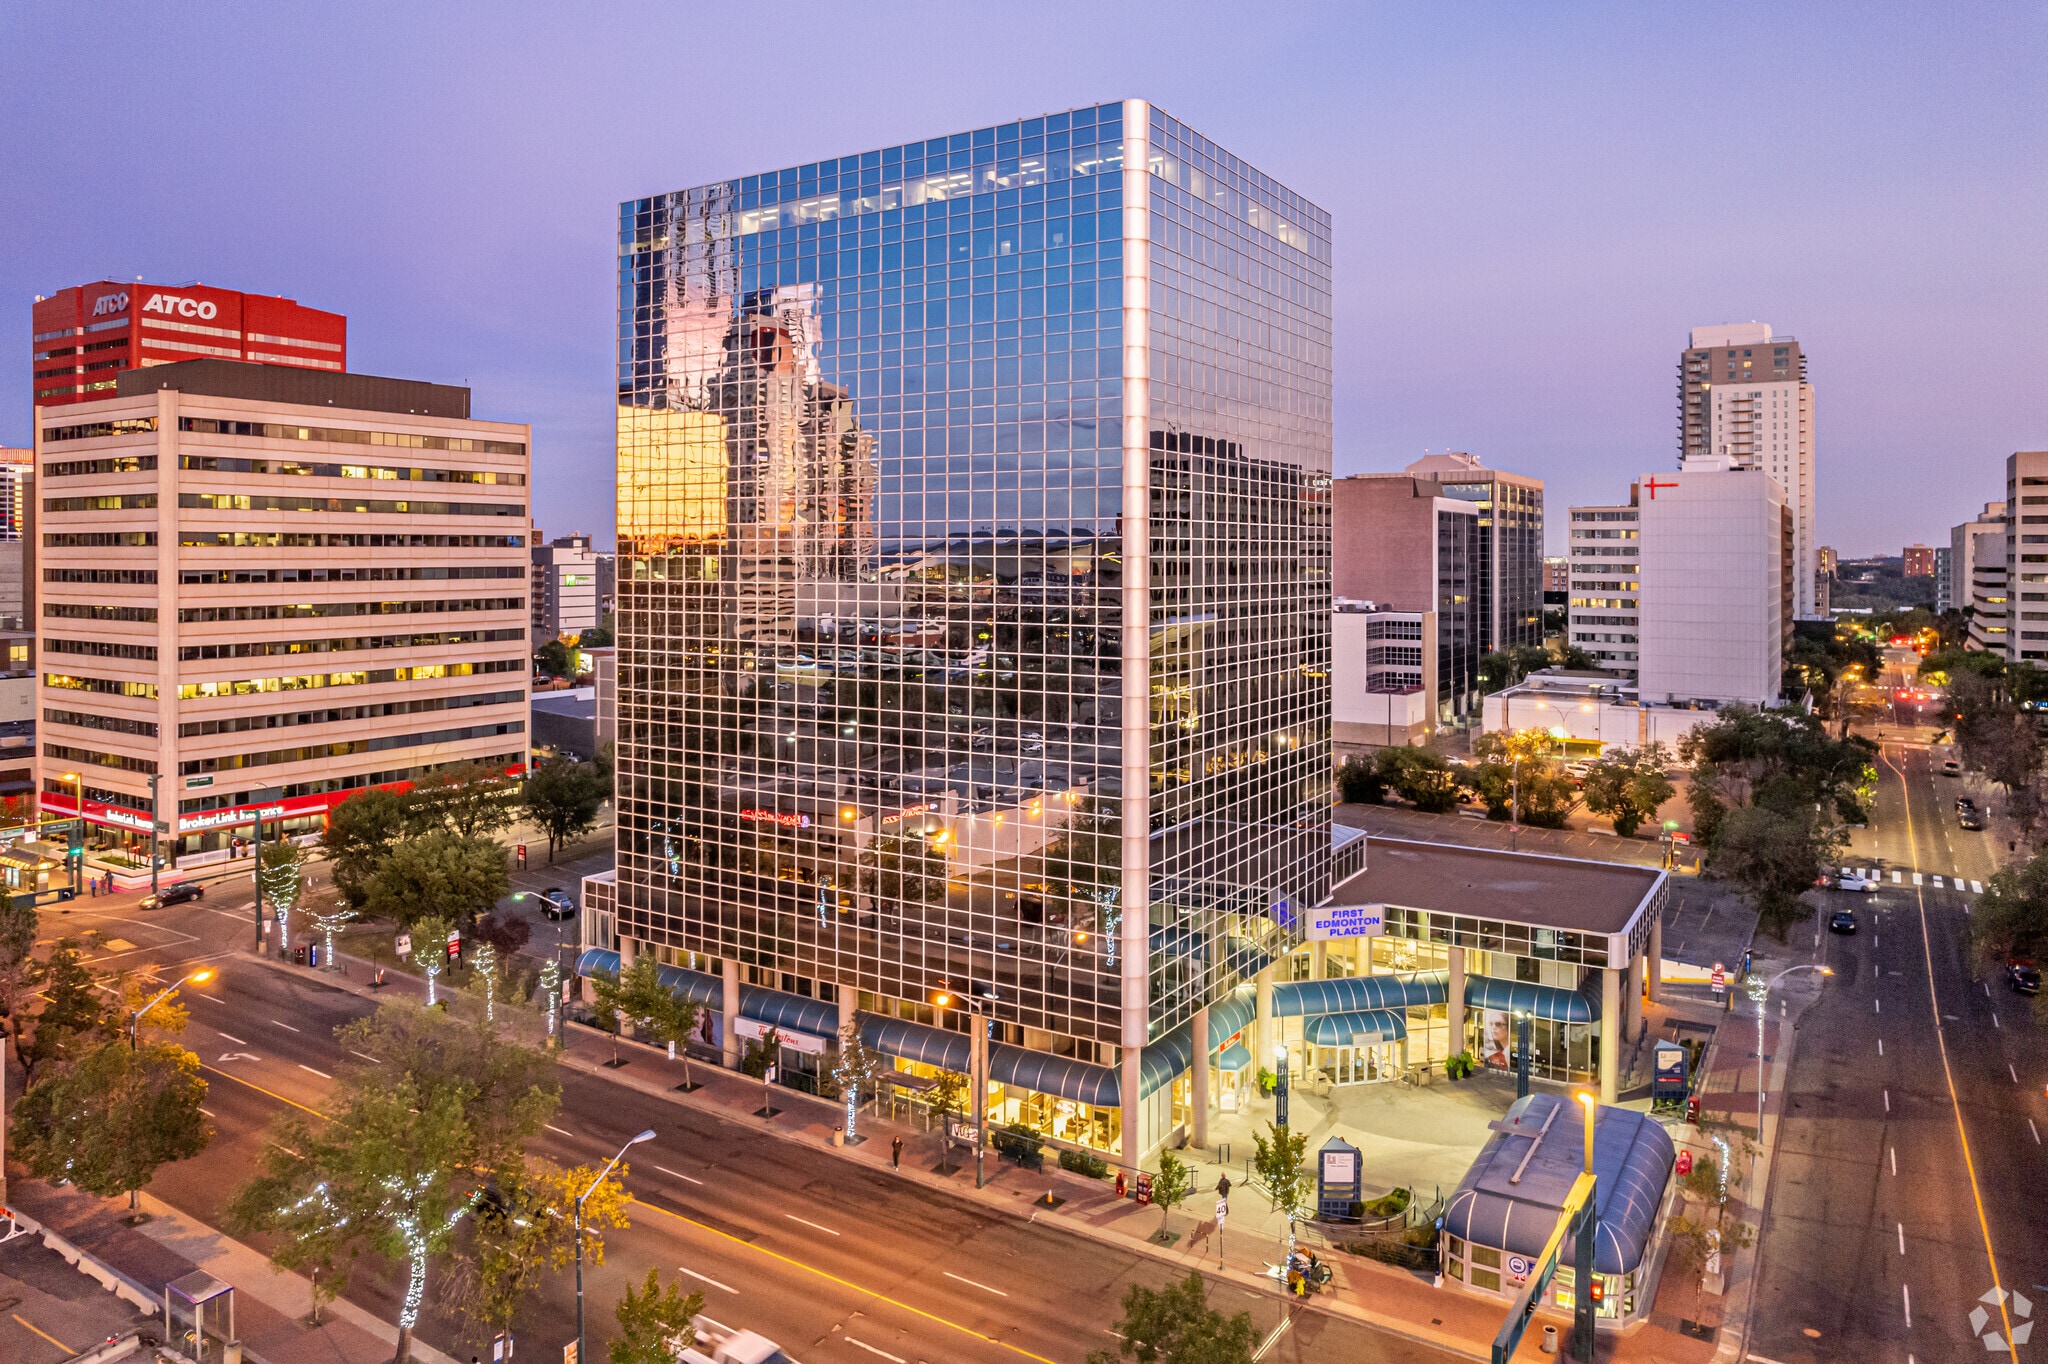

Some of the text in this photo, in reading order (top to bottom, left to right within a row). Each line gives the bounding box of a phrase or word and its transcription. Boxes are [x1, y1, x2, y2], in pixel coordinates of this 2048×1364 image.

[92, 292, 129, 317] ATCO
[142, 293, 217, 320] ATCO
[180, 810, 237, 830] BrokerLink
[1332, 909, 1364, 918] FIRST
[1316, 917, 1380, 929] EDMONTON
[1330, 927, 1366, 936] PLACE
[1216, 1205, 1226, 1214] 40
